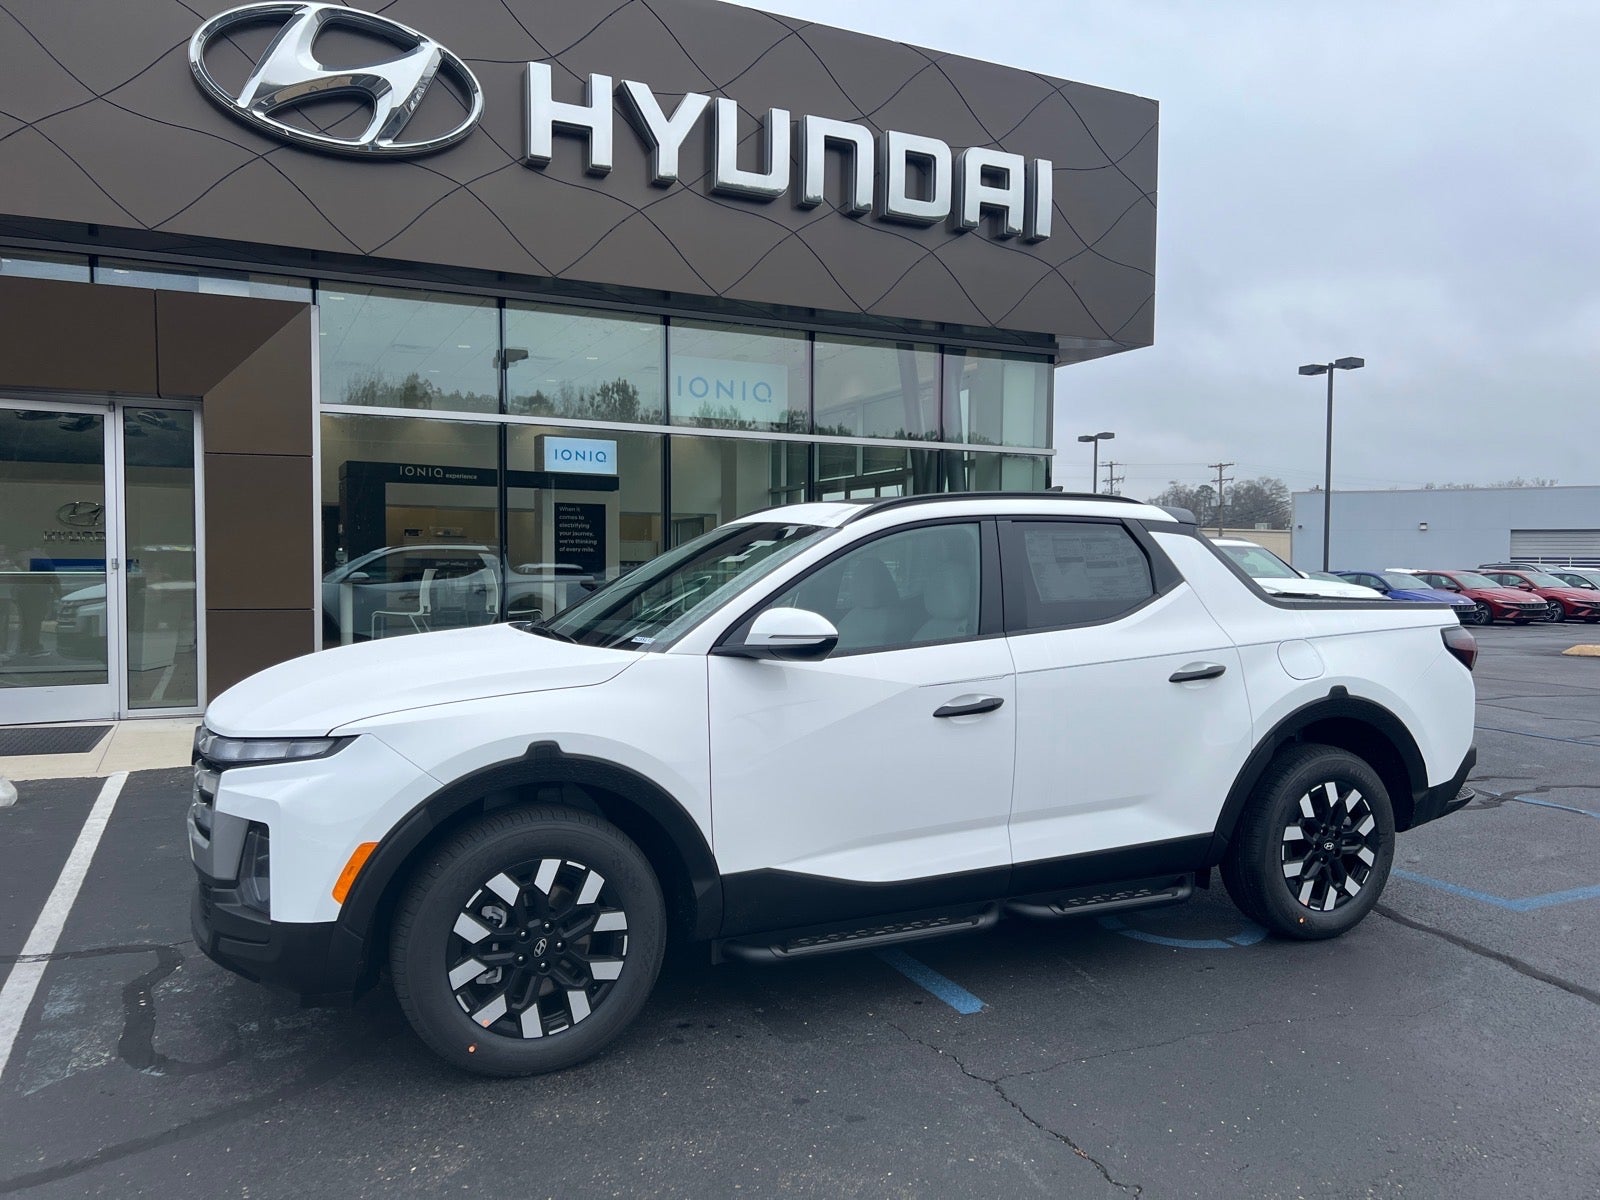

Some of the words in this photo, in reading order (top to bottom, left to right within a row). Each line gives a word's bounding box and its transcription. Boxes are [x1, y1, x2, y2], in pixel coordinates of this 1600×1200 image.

[524, 61, 1053, 244] HYUNDAI
[677, 375, 771, 403] IONIQ
[554, 449, 606, 462] IONIQ
[399, 465, 444, 478] IONIQ
[43, 531, 105, 542] HYUND
